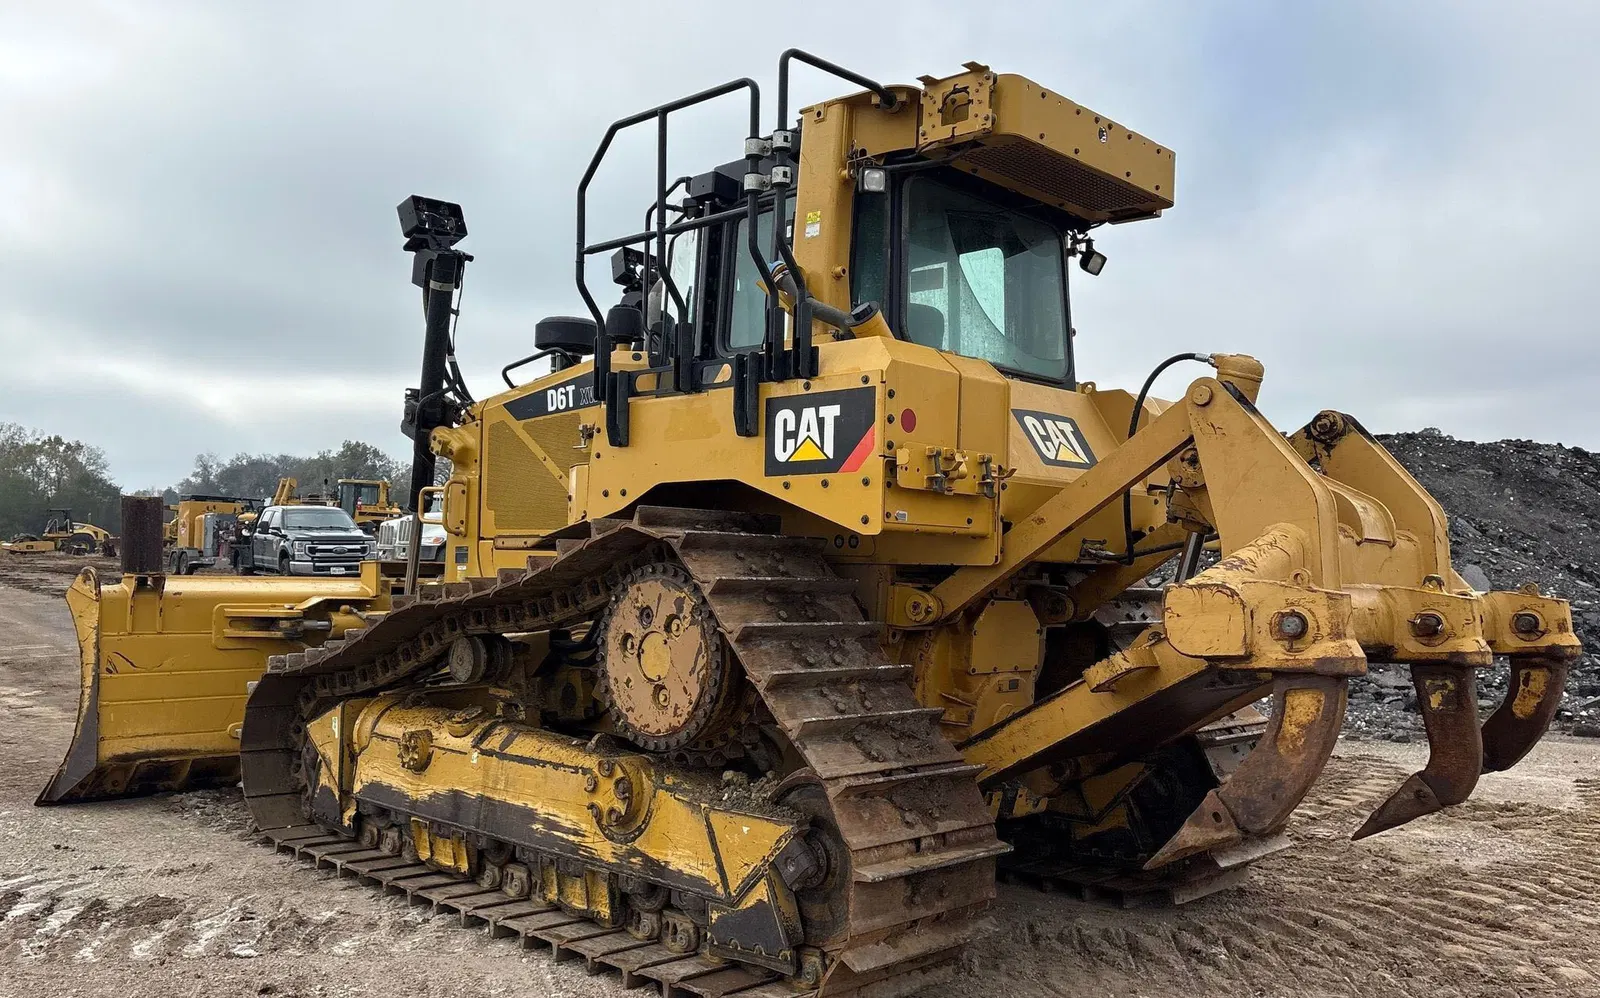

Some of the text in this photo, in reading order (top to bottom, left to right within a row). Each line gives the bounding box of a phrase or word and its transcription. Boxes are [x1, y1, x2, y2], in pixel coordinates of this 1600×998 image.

[547, 385, 575, 411] D6T
[775, 405, 840, 462] CAT
[1024, 416, 1090, 463] CAT
